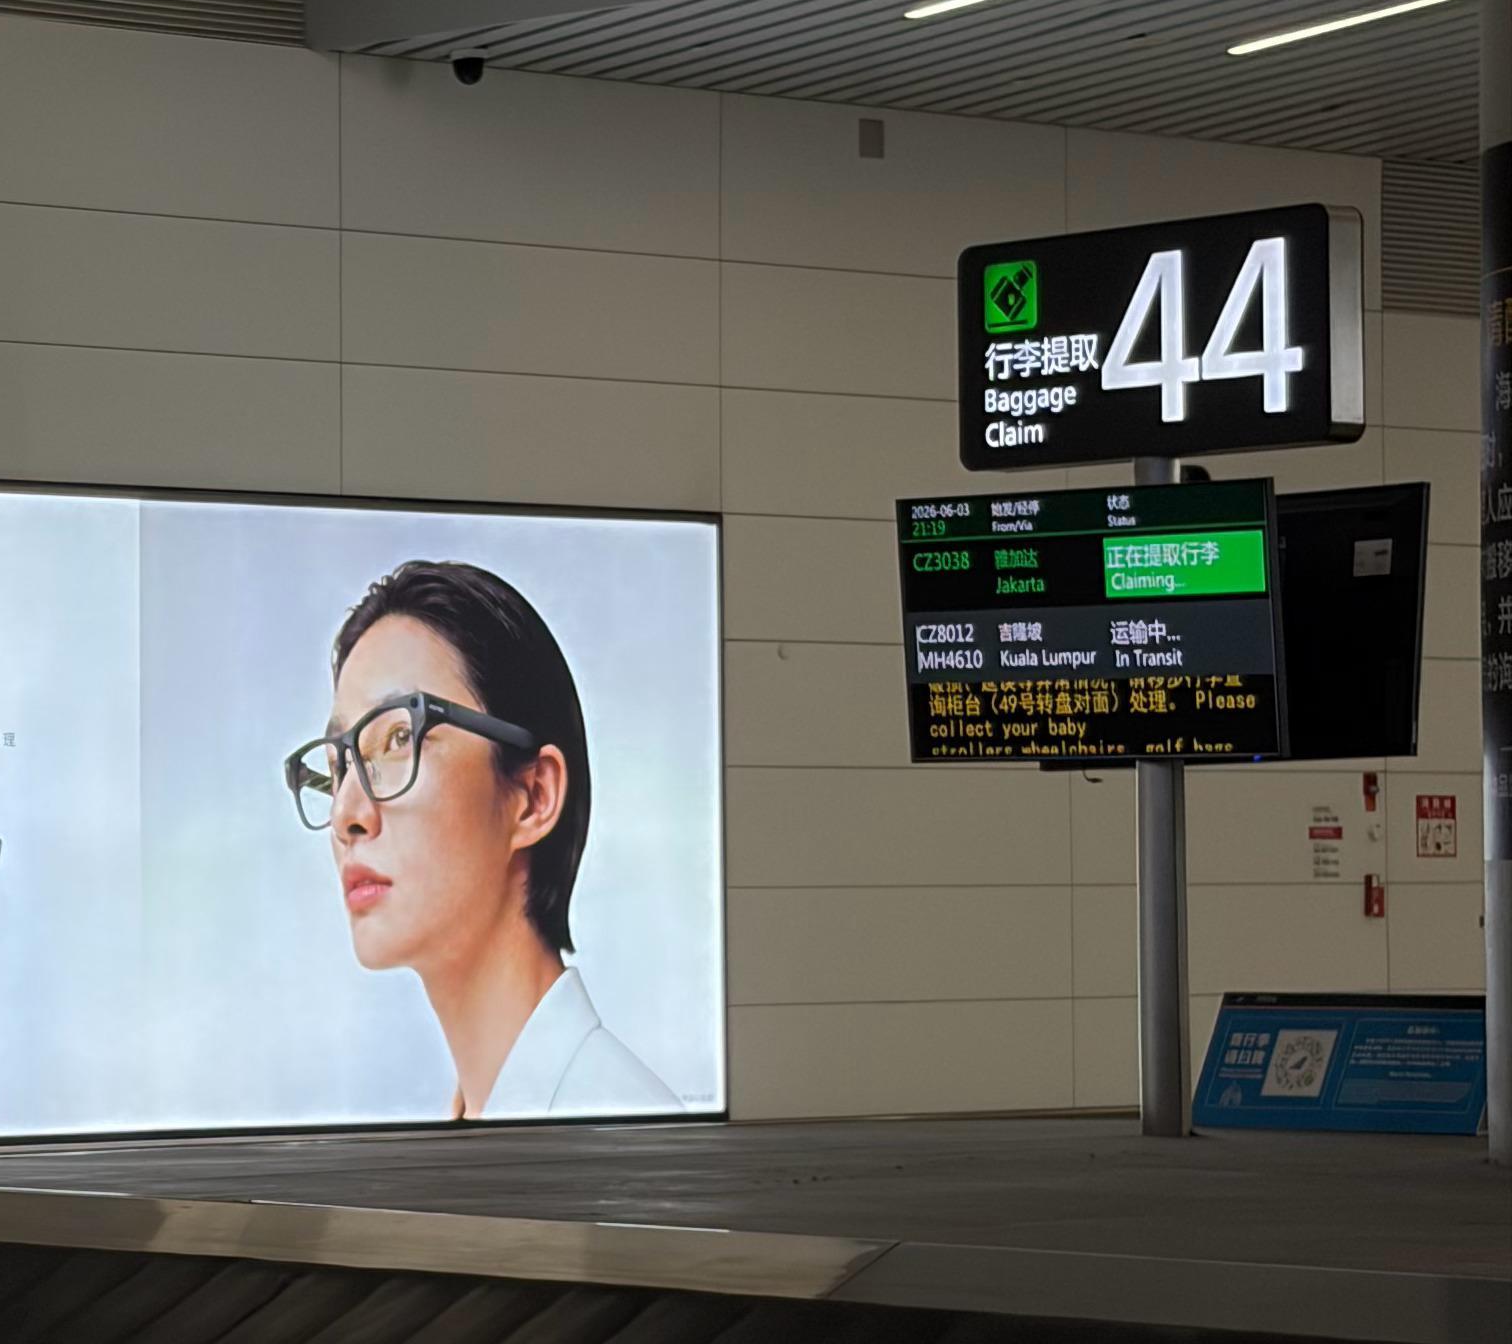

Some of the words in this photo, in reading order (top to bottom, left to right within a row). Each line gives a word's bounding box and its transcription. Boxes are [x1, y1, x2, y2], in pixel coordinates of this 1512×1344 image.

[1101, 236, 1303, 423] 44
[984, 333, 1100, 381] 行李提取
[984, 384, 1077, 417] Baggage
[984, 419, 1045, 449] Claim
[912, 502, 970, 520] 2026-06-03
[1107, 494, 1131, 511] 状态
[912, 520, 946, 537] 21:19
[1107, 514, 1137, 528] Status
[912, 551, 971, 573] CZ3038
[1107, 541, 1220, 569] 正在提取行李
[995, 575, 1046, 595] Jakarta
[917, 624, 975, 644] CZ8012
[998, 621, 1043, 643] 吉隆坡
[918, 649, 984, 670] MH4610
[1000, 649, 1039, 668] Kuala
[1042, 649, 1098, 671] Lumpur
[1116, 649, 1131, 668] In
[1133, 649, 1184, 668] Transit
[1195, 689, 1257, 711] Please
[929, 718, 994, 738] collect
[1001, 721, 1039, 740] your
[1048, 716, 1087, 739] baby
